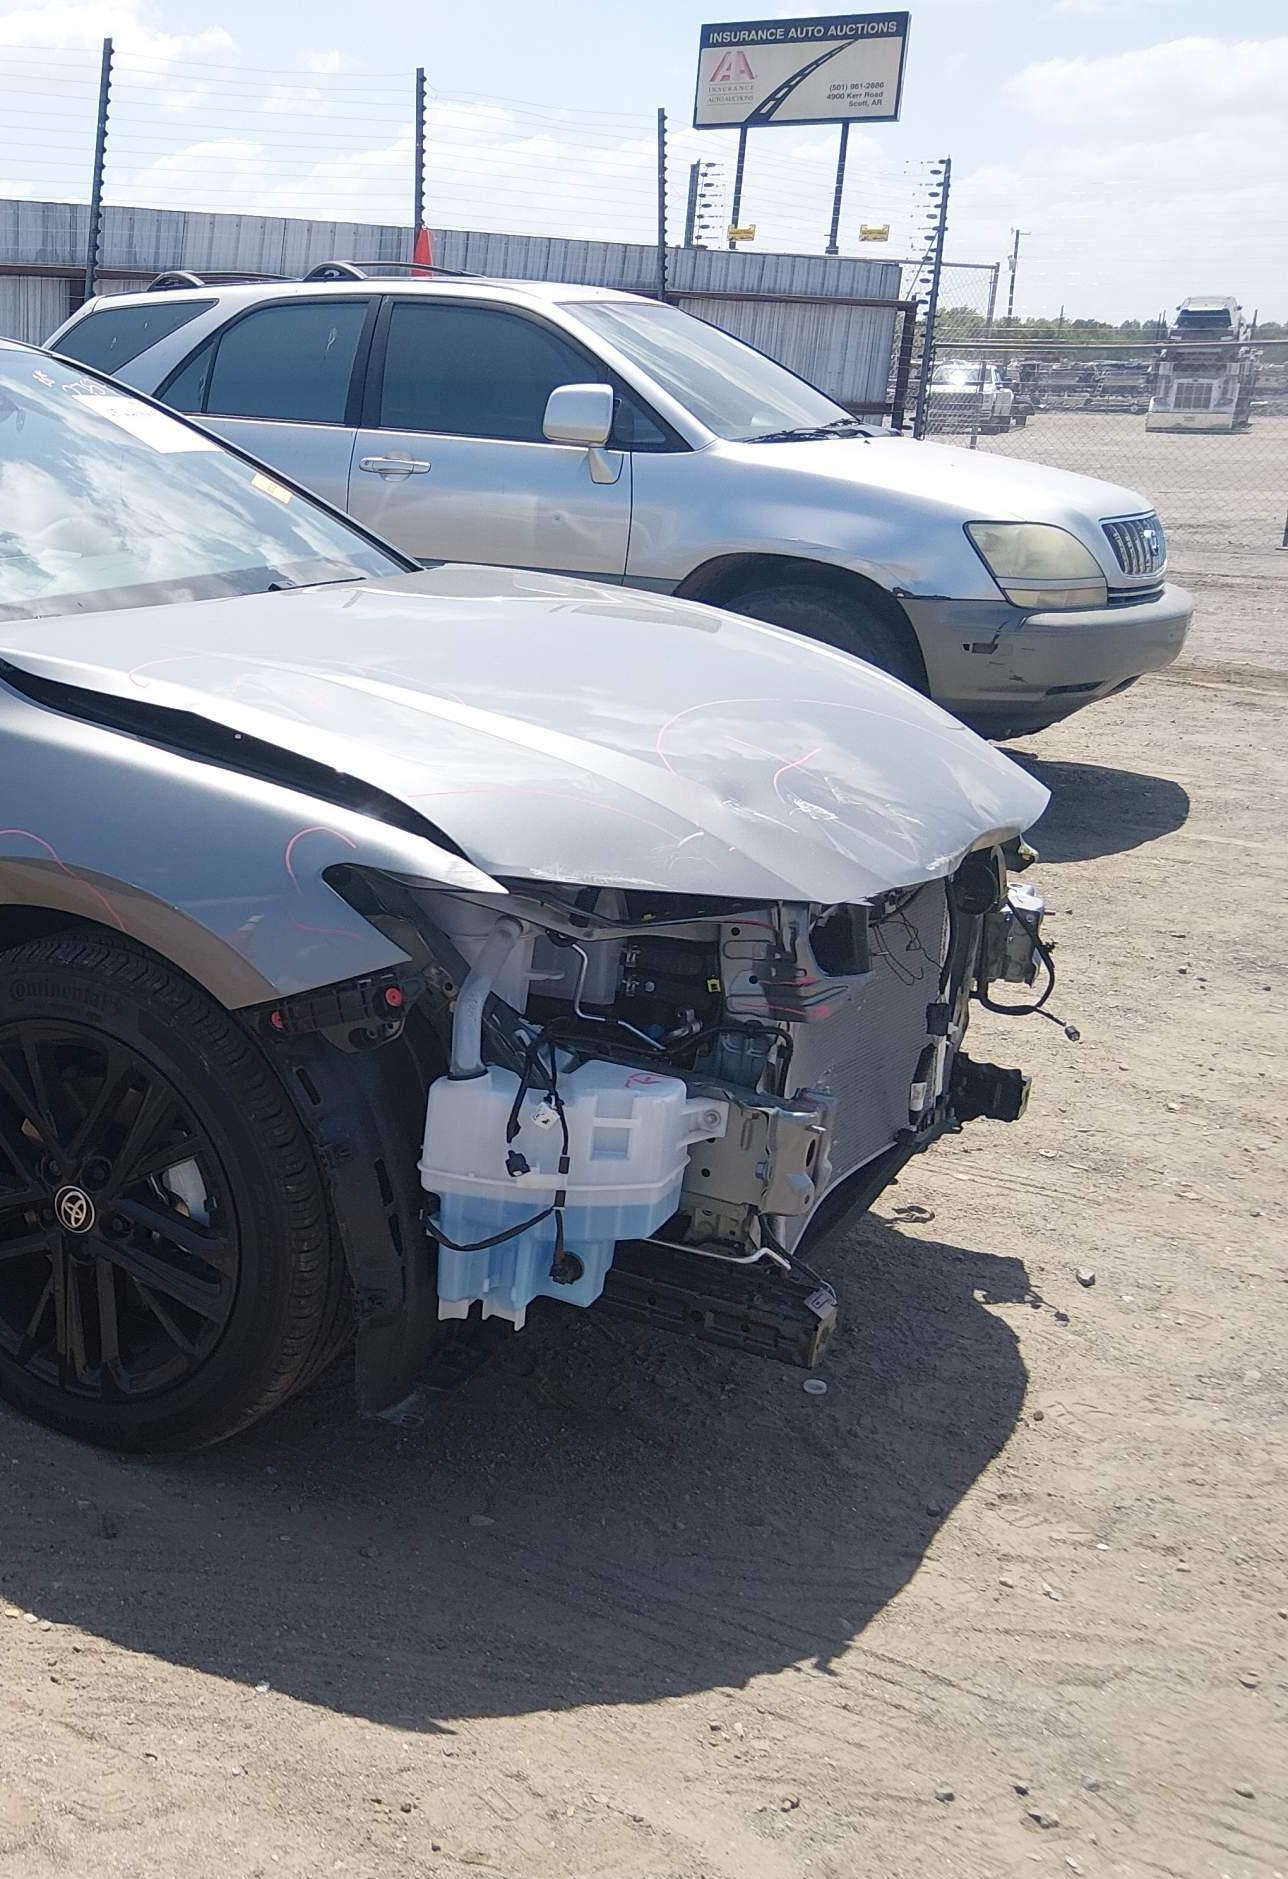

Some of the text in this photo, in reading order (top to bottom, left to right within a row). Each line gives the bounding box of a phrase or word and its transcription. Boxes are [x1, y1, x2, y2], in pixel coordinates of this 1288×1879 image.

[709, 21, 898, 45] INSURANCE AUTO AUCTIONS
[829, 83, 848, 92] (501)
[9, 977, 107, 1010] Continental
